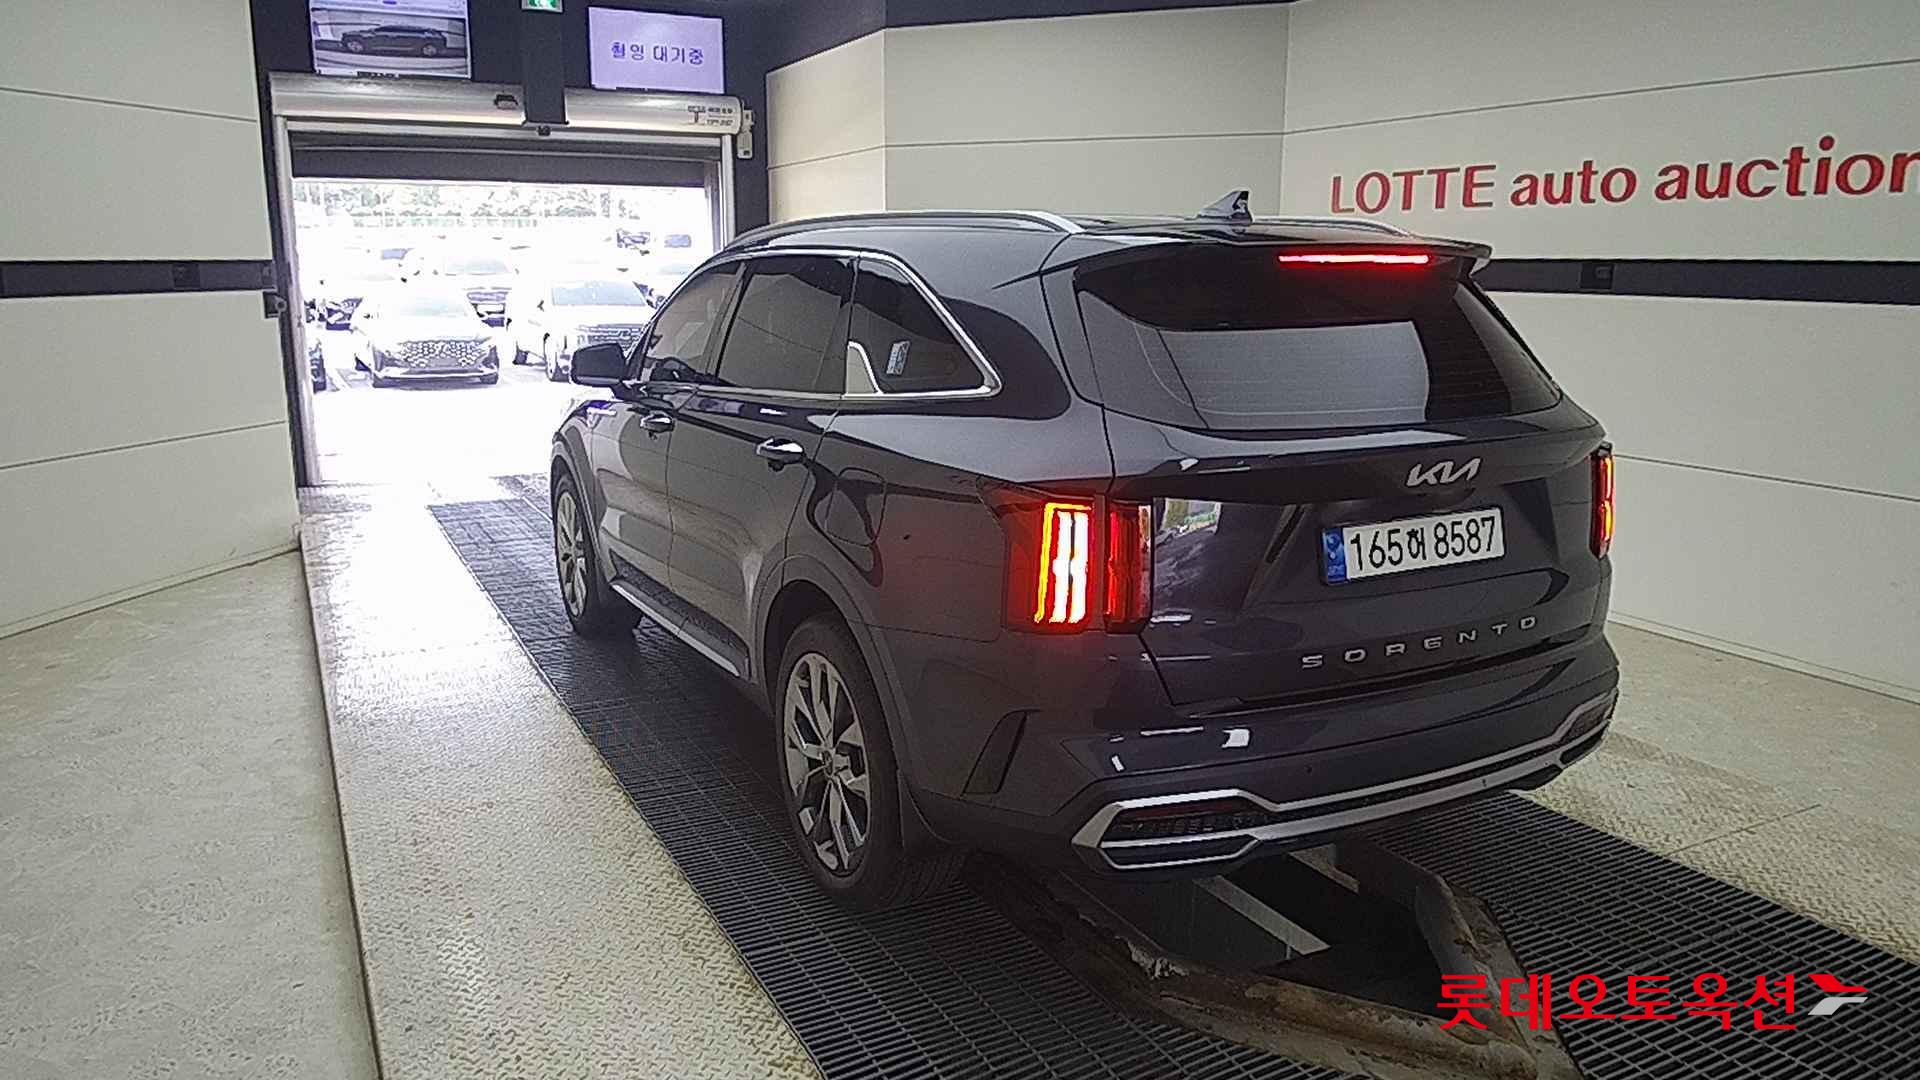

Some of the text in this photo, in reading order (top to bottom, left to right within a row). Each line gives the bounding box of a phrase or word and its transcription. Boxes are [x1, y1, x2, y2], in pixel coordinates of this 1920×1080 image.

[653, 45, 703, 65] 대기중
[1331, 164, 1497, 213] LOTTE
[1511, 160, 1637, 206] auto
[1433, 516, 1495, 559] 8587
[1300, 616, 1538, 669] SORENTO
